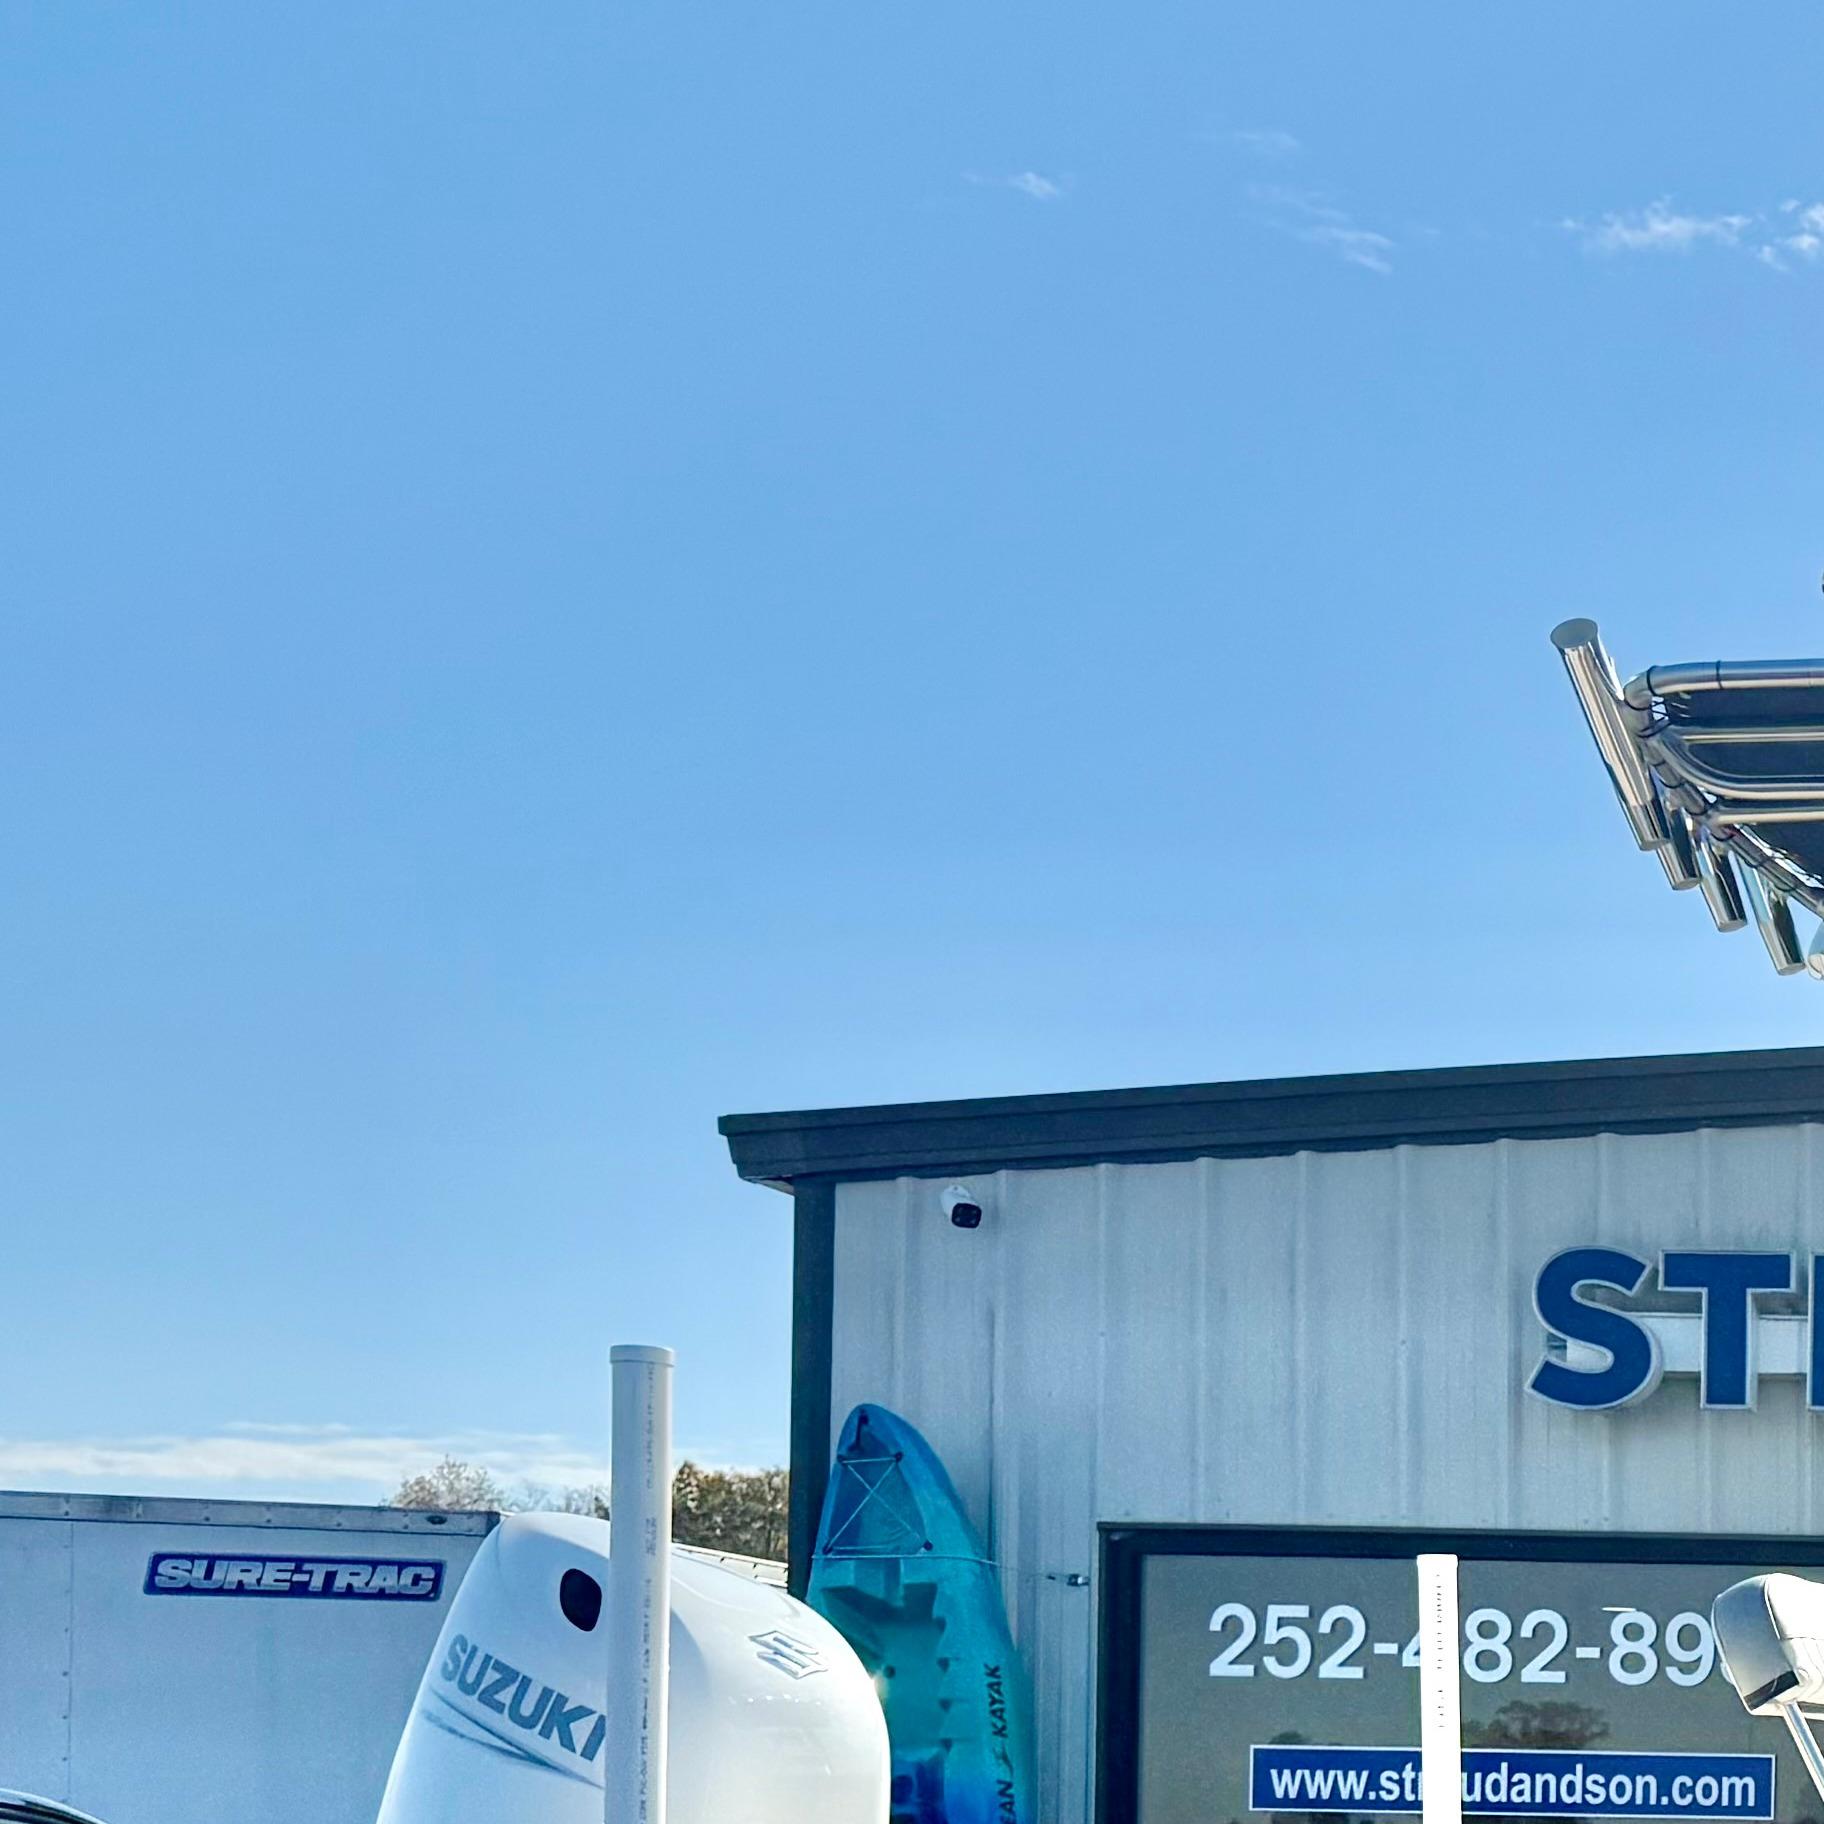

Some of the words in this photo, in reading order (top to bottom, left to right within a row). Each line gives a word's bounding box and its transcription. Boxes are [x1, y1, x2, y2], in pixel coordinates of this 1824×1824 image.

[154, 1559, 436, 1596] SURE-TRAC
[440, 1633, 607, 1762] SUZUKI
[984, 1663, 1008, 1738] KAYAK
[1270, 1761, 1756, 1808] www.studandson.com
